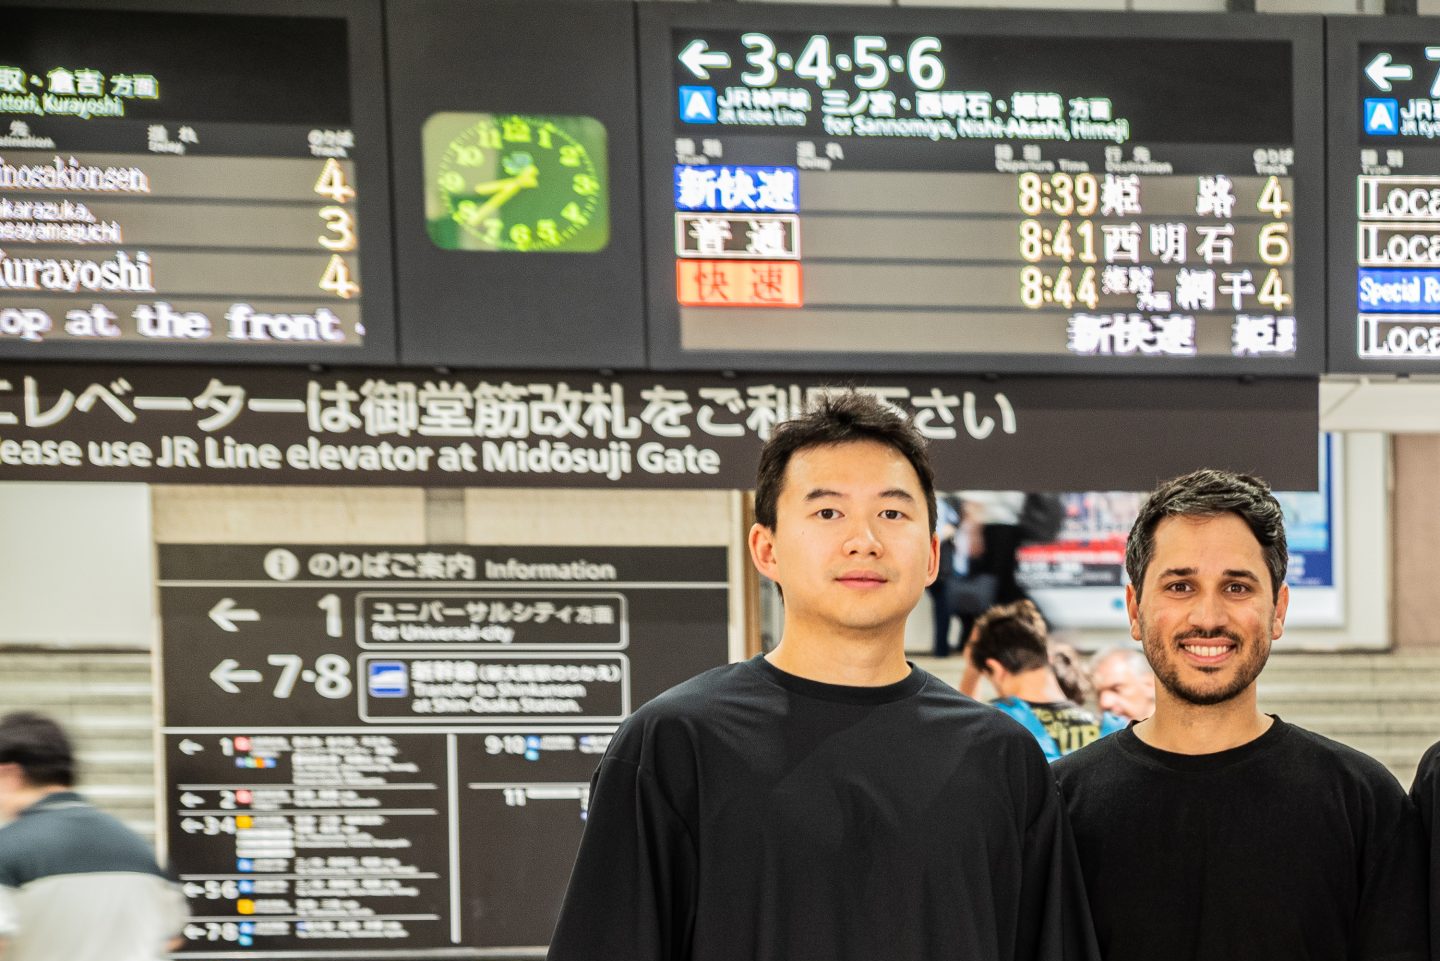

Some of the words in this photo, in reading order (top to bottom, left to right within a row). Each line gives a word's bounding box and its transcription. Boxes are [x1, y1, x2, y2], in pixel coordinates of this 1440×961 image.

[44, 95, 125, 119] Kurayoshi
[683, 91, 712, 120] A
[1369, 102, 1394, 130] A
[1071, 118, 1130, 143] Himeji
[315, 158, 355, 203] 4
[677, 167, 797, 211] 新快速
[1018, 172, 1098, 216] 8:39
[1257, 175, 1291, 218] 4
[318, 205, 354, 251] 3
[688, 218, 789, 255] 普通
[1018, 219, 1098, 263] 8:41
[1101, 223, 1235, 264] 西明石
[1258, 222, 1290, 264] 6
[319, 254, 360, 299] 4
[692, 266, 784, 303] 快速
[1020, 266, 1099, 310] 8:44
[1257, 269, 1291, 311] 4
[1359, 277, 1421, 307] Special
[65, 303, 121, 338] at
[133, 301, 212, 340] the
[226, 302, 346, 342] front
[1067, 313, 1197, 356] 新快速
[0, 434, 83, 468] ease
[88, 440, 152, 469] use
[156, 436, 201, 470] JR
[204, 437, 283, 471] Line
[286, 438, 434, 473] elevator
[437, 442, 477, 472] at
[481, 436, 632, 481] Midōsuji
[637, 441, 721, 475] Gate
[307, 552, 477, 580] のりばご案内
[484, 557, 617, 581] Information
[317, 593, 343, 638] 1
